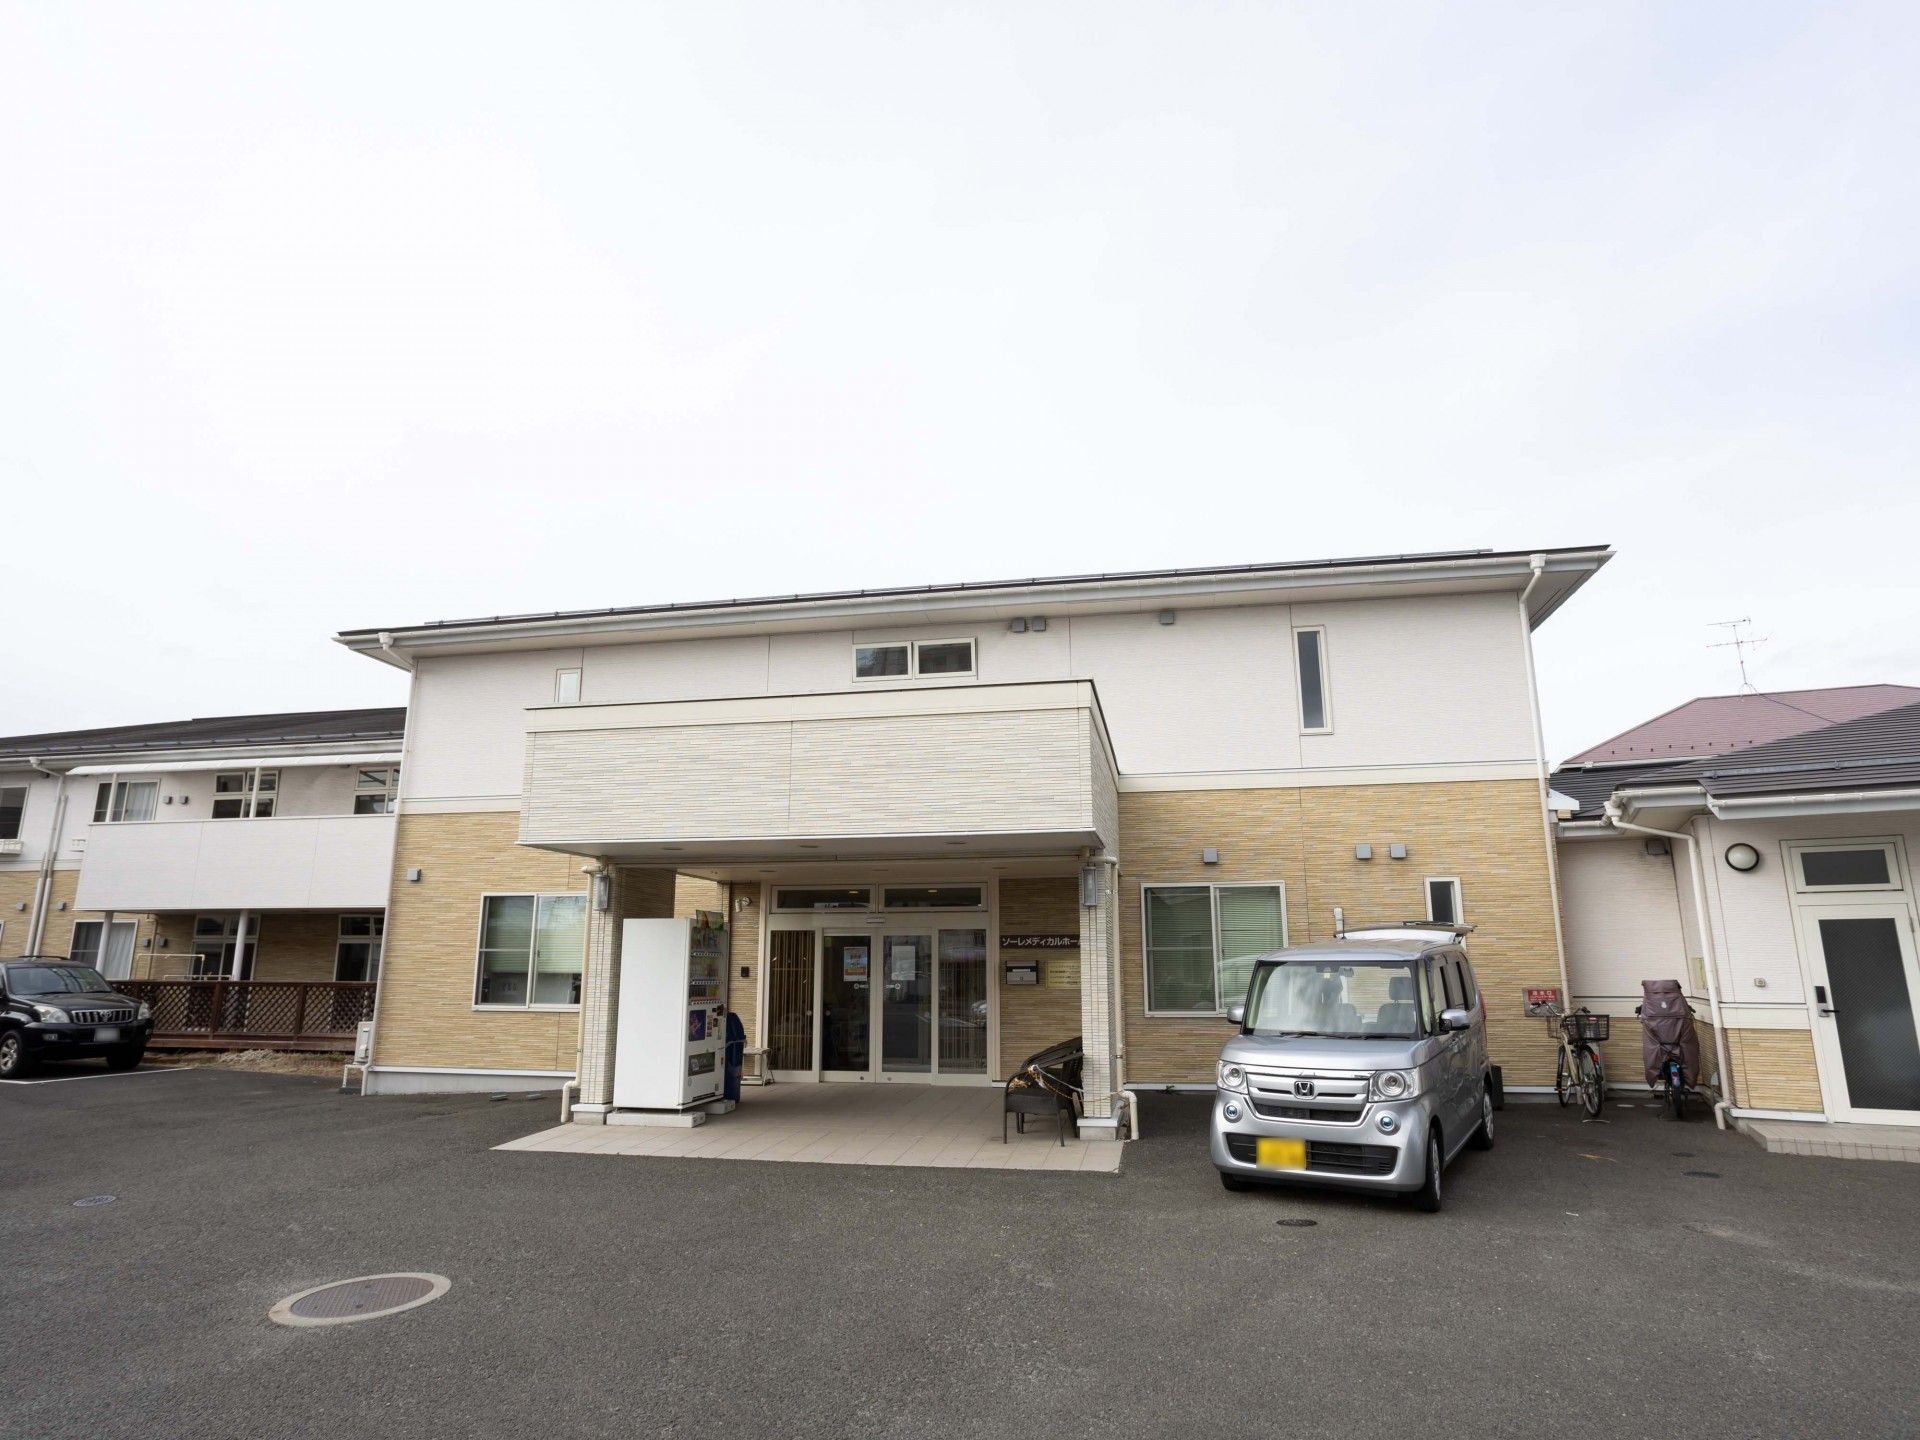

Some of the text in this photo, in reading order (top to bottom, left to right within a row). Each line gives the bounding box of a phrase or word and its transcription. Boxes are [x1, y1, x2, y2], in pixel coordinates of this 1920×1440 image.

[1002, 936, 1080, 946] ソーレメディカルホー
